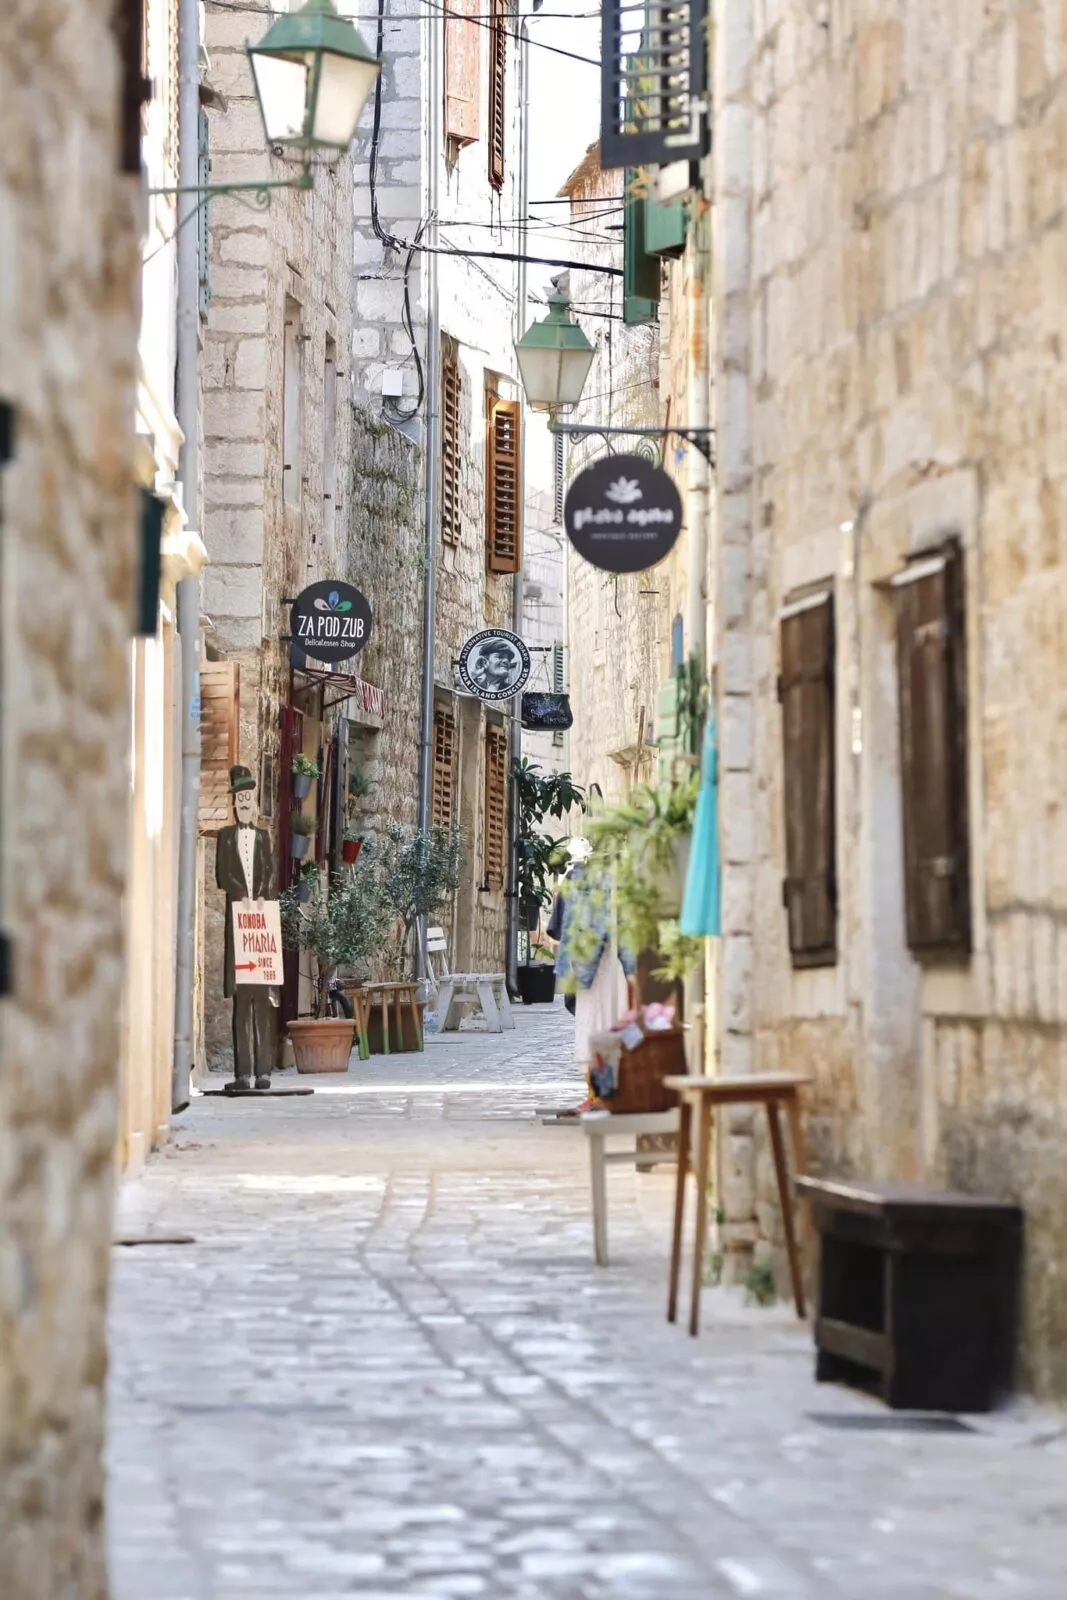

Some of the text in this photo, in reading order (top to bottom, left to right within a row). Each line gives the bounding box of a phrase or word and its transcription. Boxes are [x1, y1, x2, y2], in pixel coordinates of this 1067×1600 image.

[298, 615, 364, 638] ZA POD ZUB
[305, 638, 356, 649] Delicatessen Shop
[463, 630, 529, 661] ALTERNATIVE TOURIST BOARD
[460, 666, 529, 699] HVAR ISLAND CONCIERGE
[237, 912, 266, 929] KONOBA
[243, 932, 277, 953] PHARIA
[258, 957, 272, 968] SINCE
